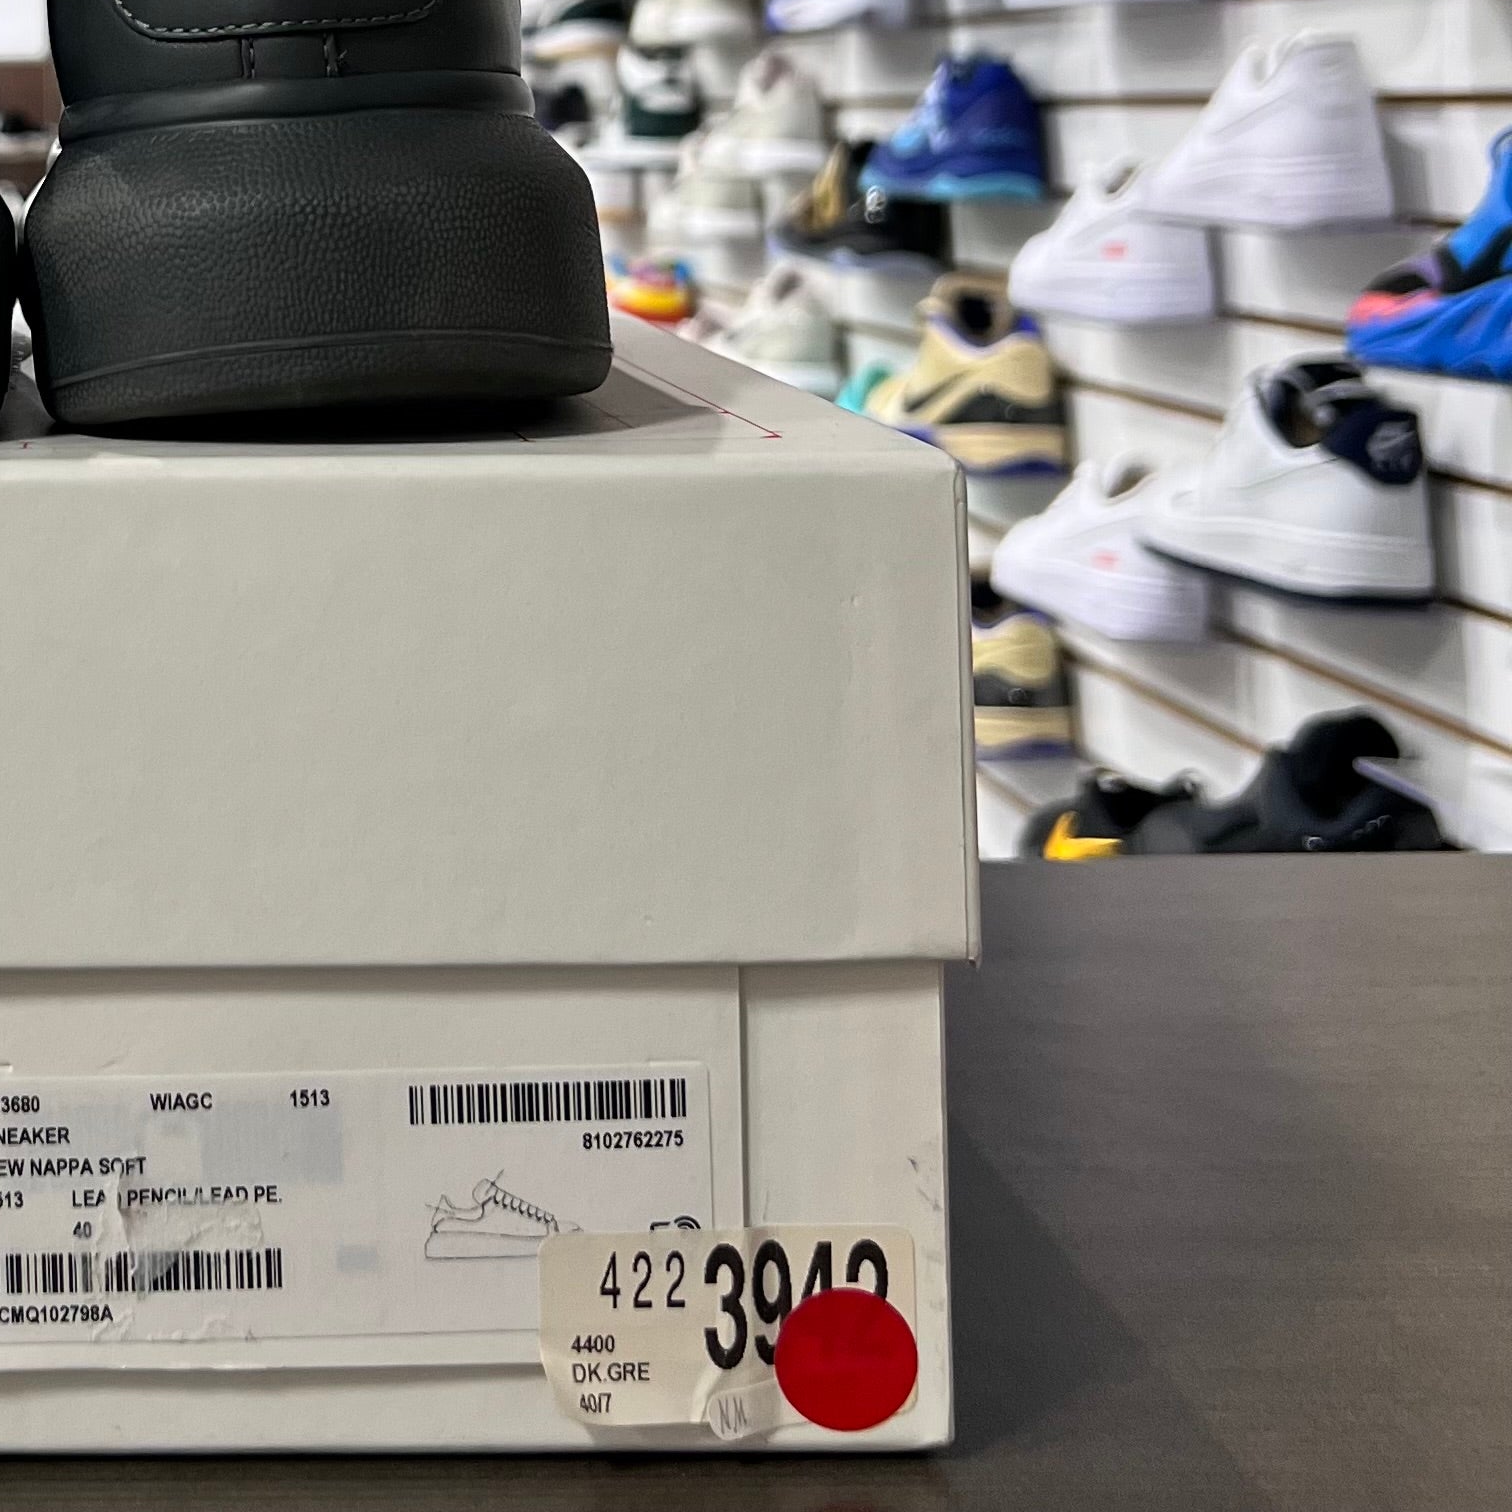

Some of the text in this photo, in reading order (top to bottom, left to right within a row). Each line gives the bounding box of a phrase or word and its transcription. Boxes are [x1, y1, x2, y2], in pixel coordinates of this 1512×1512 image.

[149, 1092, 213, 1112] WIAGC
[289, 1088, 331, 1109] 1513
[582, 1129, 685, 1150] 8102762275
[29, 1157, 94, 1178] NAPPA
[98, 1156, 147, 1176] SOFT
[254, 1185, 283, 1204] PE.
[599, 1250, 686, 1309] 422
[571, 1334, 615, 1354] 4400
[572, 1362, 651, 1384] DK.GRE
